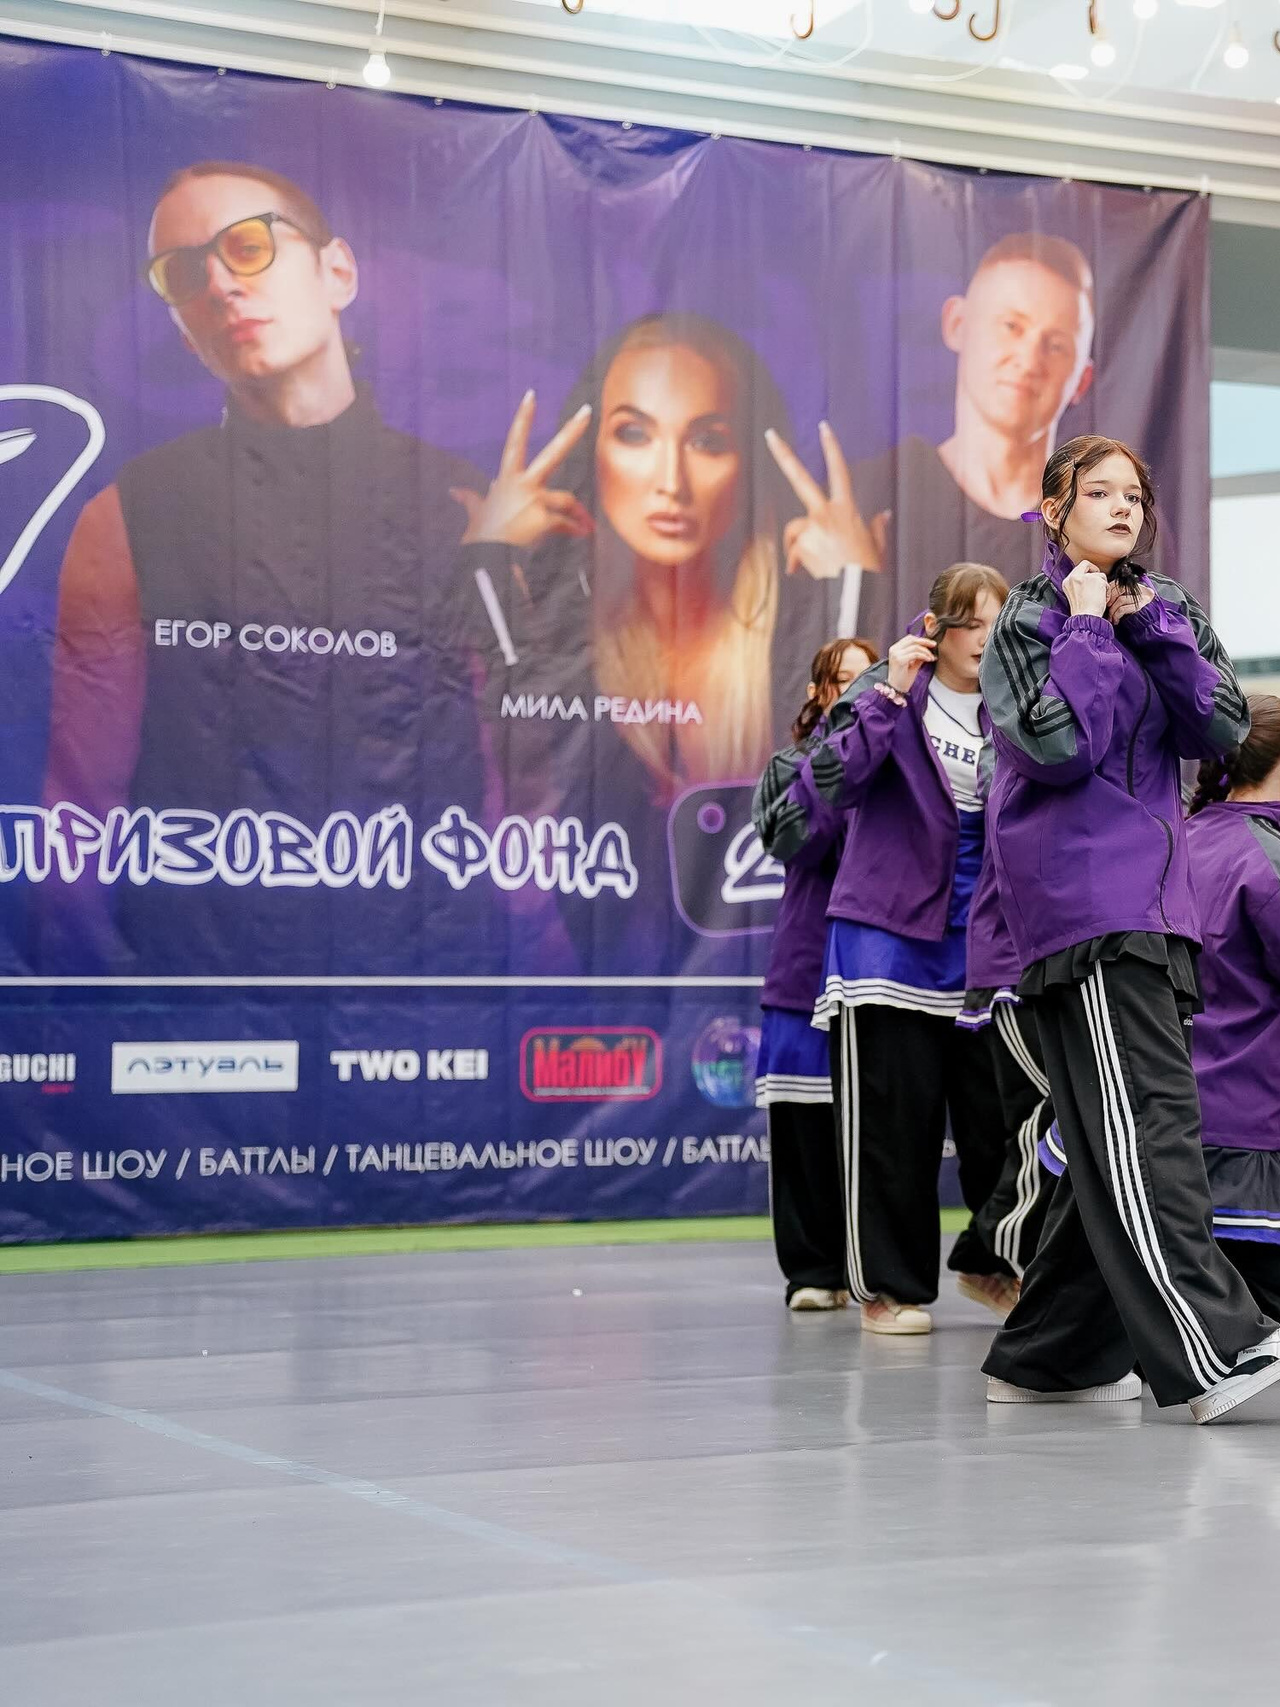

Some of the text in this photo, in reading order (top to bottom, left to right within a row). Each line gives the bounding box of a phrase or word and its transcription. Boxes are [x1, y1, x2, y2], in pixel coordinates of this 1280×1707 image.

[155, 618, 398, 658] ЕГОР СОКОЛОВ
[500, 693, 703, 725] МИЛА РЕДИНА
[0, 801, 638, 899] ПРИЗОВОЙ ФОНД
[329, 1049, 489, 1081] TWO KEI
[1, 1151, 74, 1182] НОЕ
[82, 1148, 167, 1181] ШОУ
[199, 1145, 315, 1177] БАТТЛЫ
[346, 1138, 578, 1173] ТАНЦЕВАЛЬНОЕ
[584, 1136, 658, 1167] ШОУ
